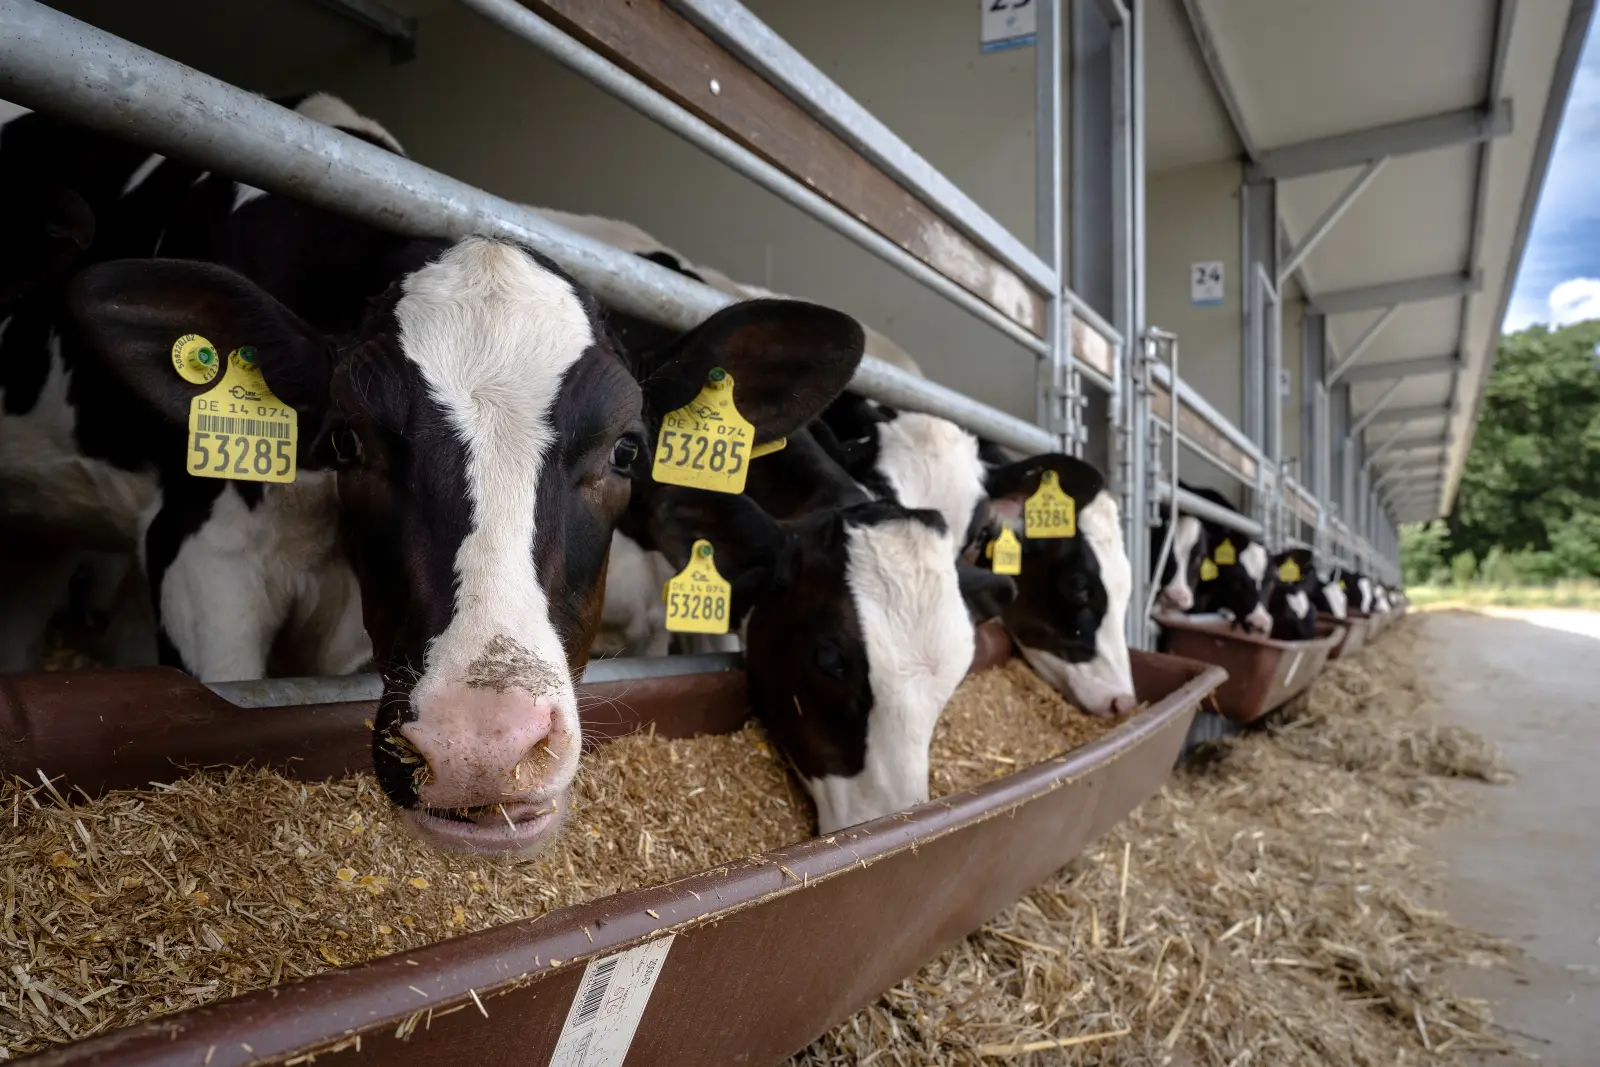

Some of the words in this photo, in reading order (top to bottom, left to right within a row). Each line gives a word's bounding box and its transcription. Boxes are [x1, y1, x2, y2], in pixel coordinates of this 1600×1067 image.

[1195, 264, 1220, 285] 24
[198, 400, 219, 411] DE
[229, 403, 249, 414] 14
[257, 406, 290, 419] 074
[667, 417, 685, 429] DE
[692, 421, 710, 432] 14
[717, 425, 745, 437] 074
[193, 432, 292, 476] 53285
[658, 430, 745, 475] 53285
[1027, 509, 1070, 528] 53284
[669, 593, 725, 620] 53288
